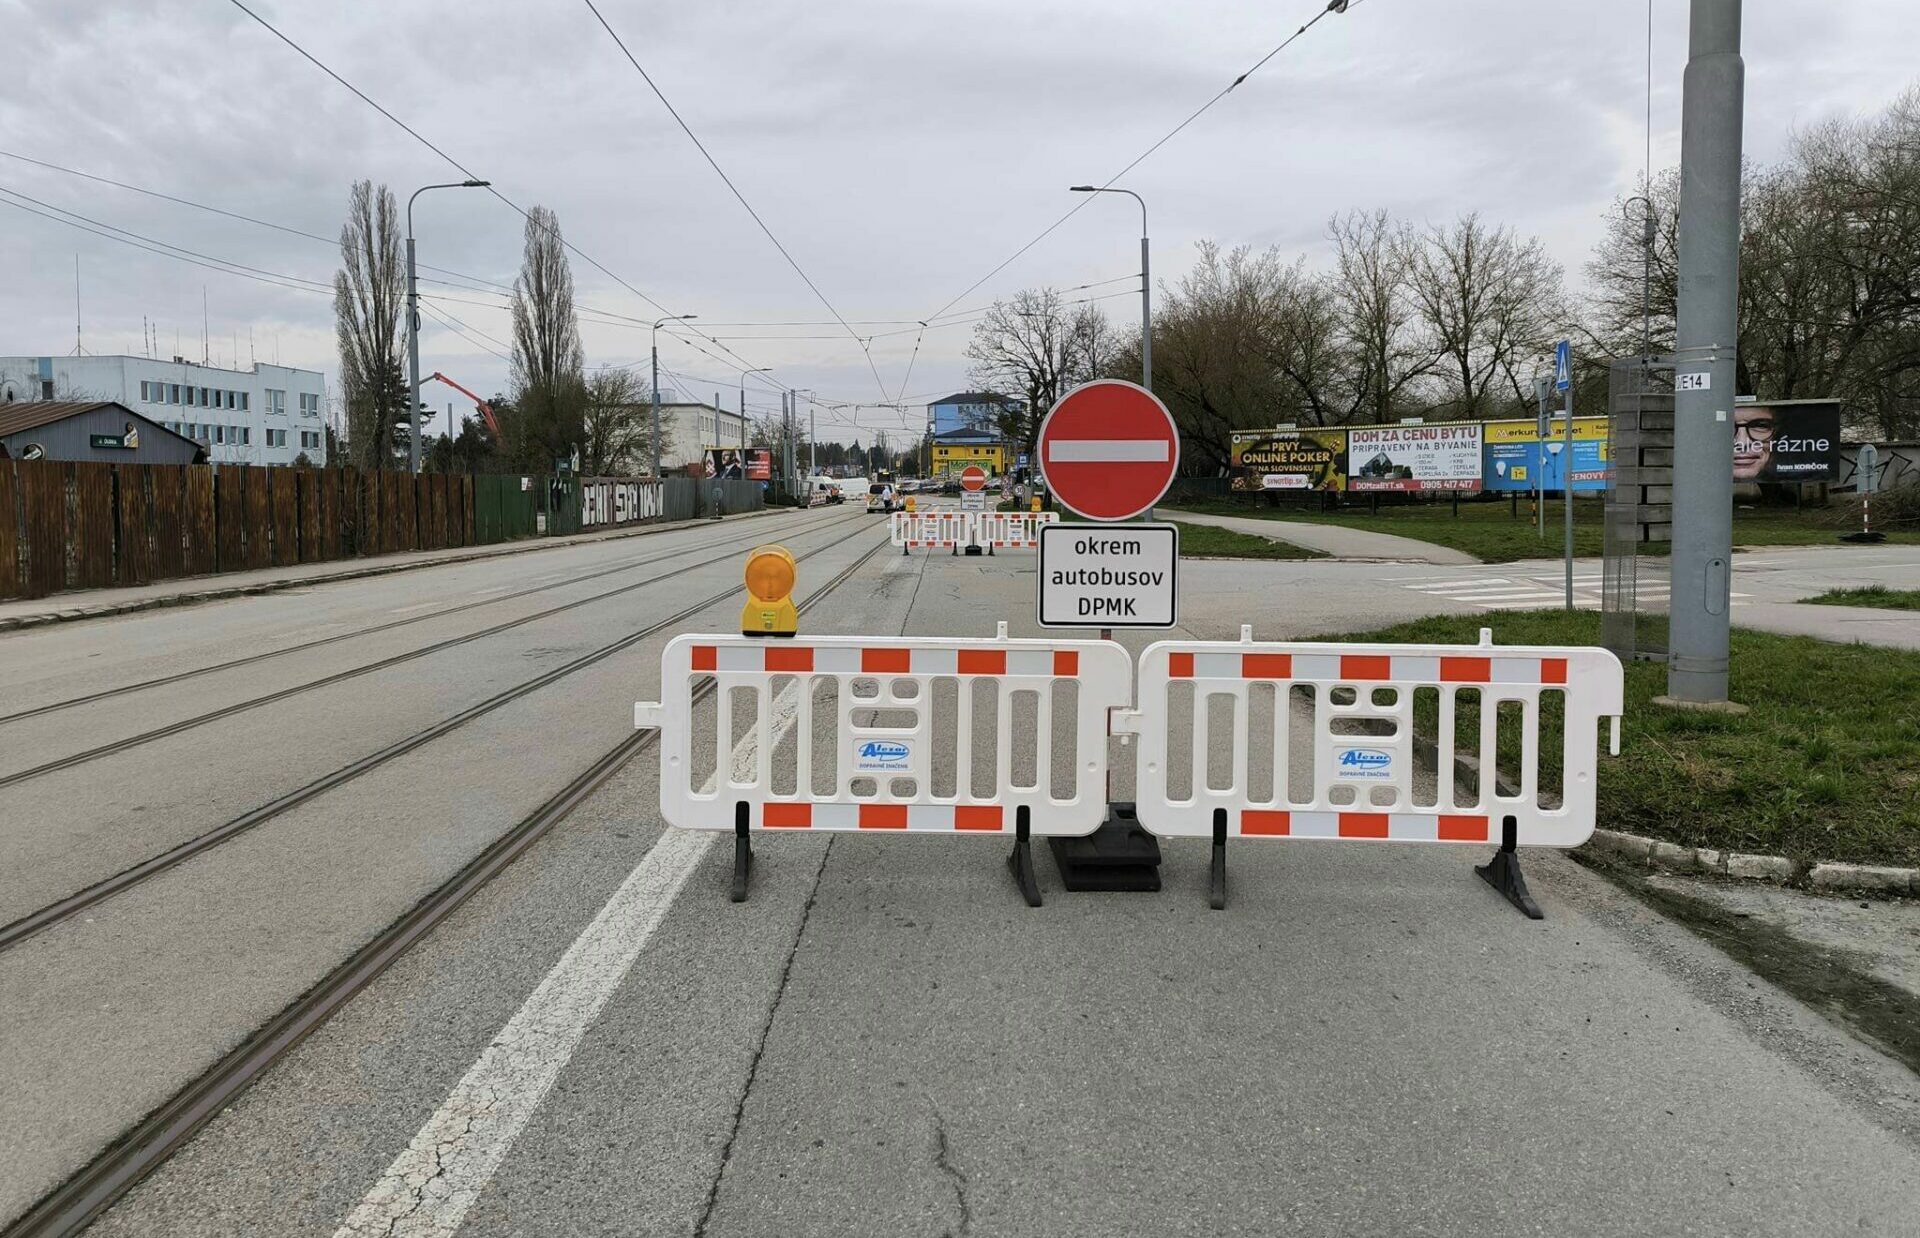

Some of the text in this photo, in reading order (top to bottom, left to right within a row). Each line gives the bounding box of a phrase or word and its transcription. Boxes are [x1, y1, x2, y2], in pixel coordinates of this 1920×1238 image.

[1352, 426, 1477, 443] DOM ZA CENU BYTU
[1416, 442, 1430, 451] NA
[1769, 435, 1830, 452] rázne
[1242, 451, 1330, 464] ONLINE POKER
[1271, 464, 1313, 472] SLOVENSKU
[1794, 461, 1829, 471] KORČOK
[1420, 480, 1473, 489] 0905 417 417
[1074, 537, 1141, 555] okrem
[1052, 568, 1164, 586] autobusov
[1078, 597, 1137, 616] DPMK
